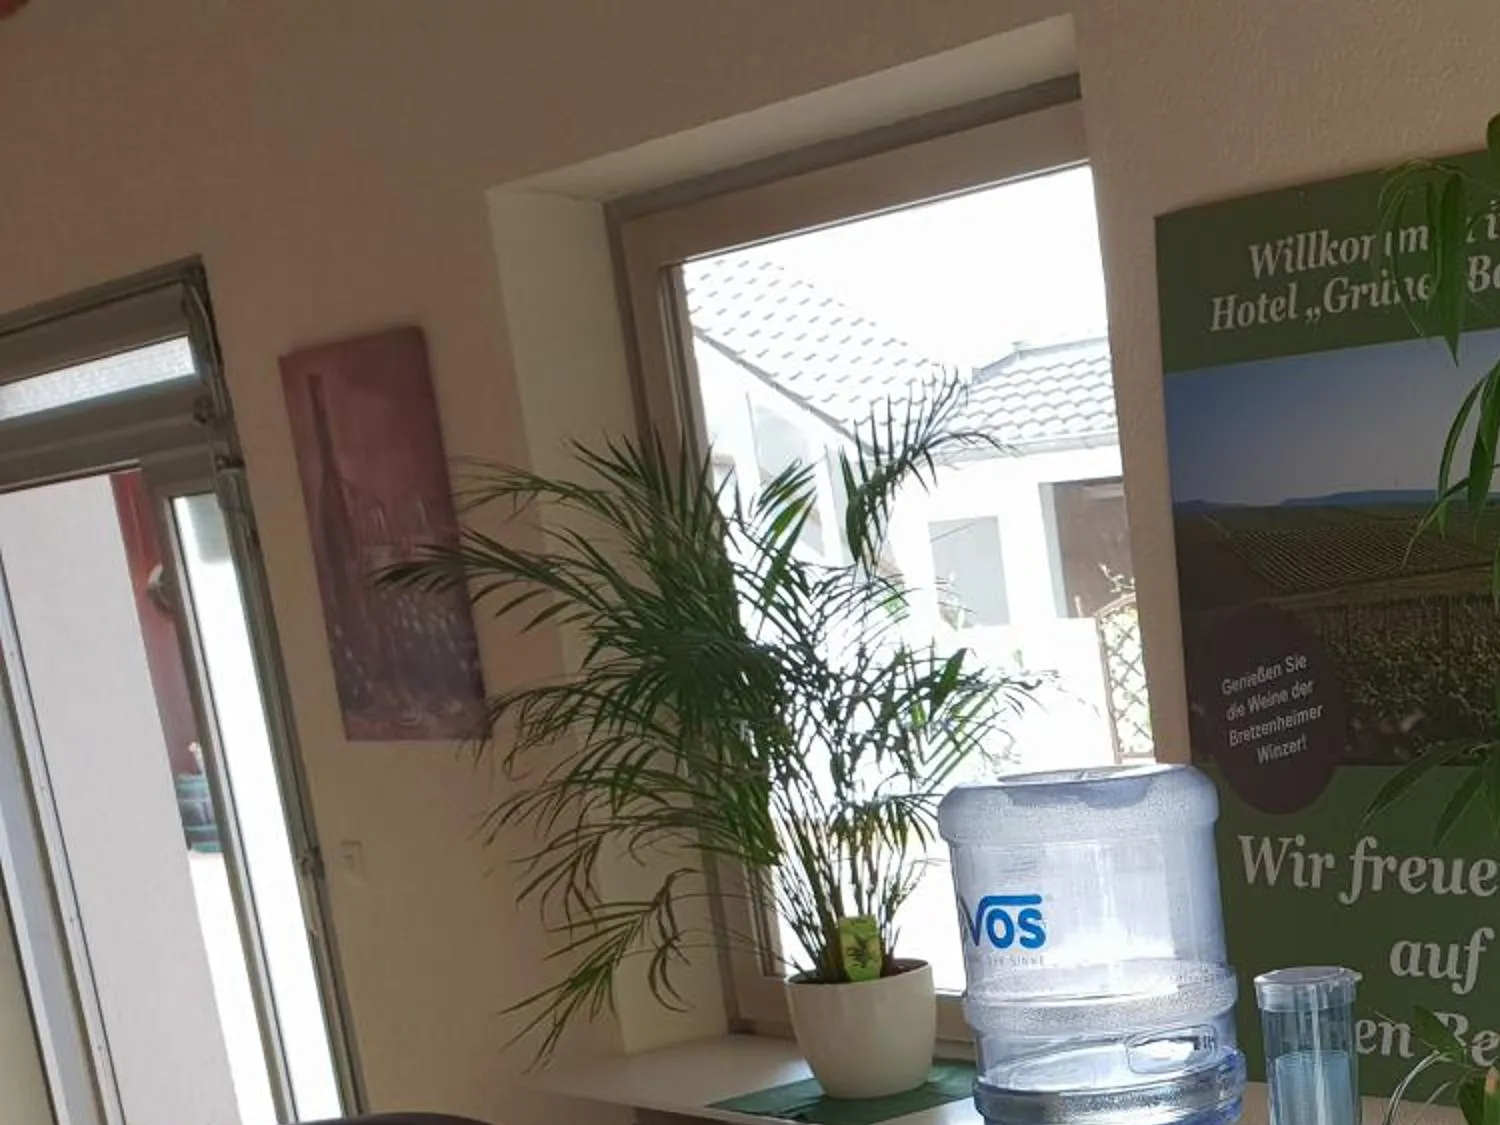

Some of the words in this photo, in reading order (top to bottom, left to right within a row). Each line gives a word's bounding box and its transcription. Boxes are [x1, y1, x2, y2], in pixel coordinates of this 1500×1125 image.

[1248, 215, 1477, 280] Willkomm
[1210, 281, 1299, 333] Hotel
[1304, 268, 1433, 325] „Grüne
[1221, 665, 1282, 696] Genießen
[1284, 654, 1308, 674] Sie
[1247, 689, 1289, 714] Weine
[1291, 680, 1314, 700] der
[1229, 704, 1324, 748] Bretzenheimer
[1256, 733, 1308, 765] Winzer!
[1238, 833, 1335, 889] Wir
[1389, 926, 1495, 996] auf
